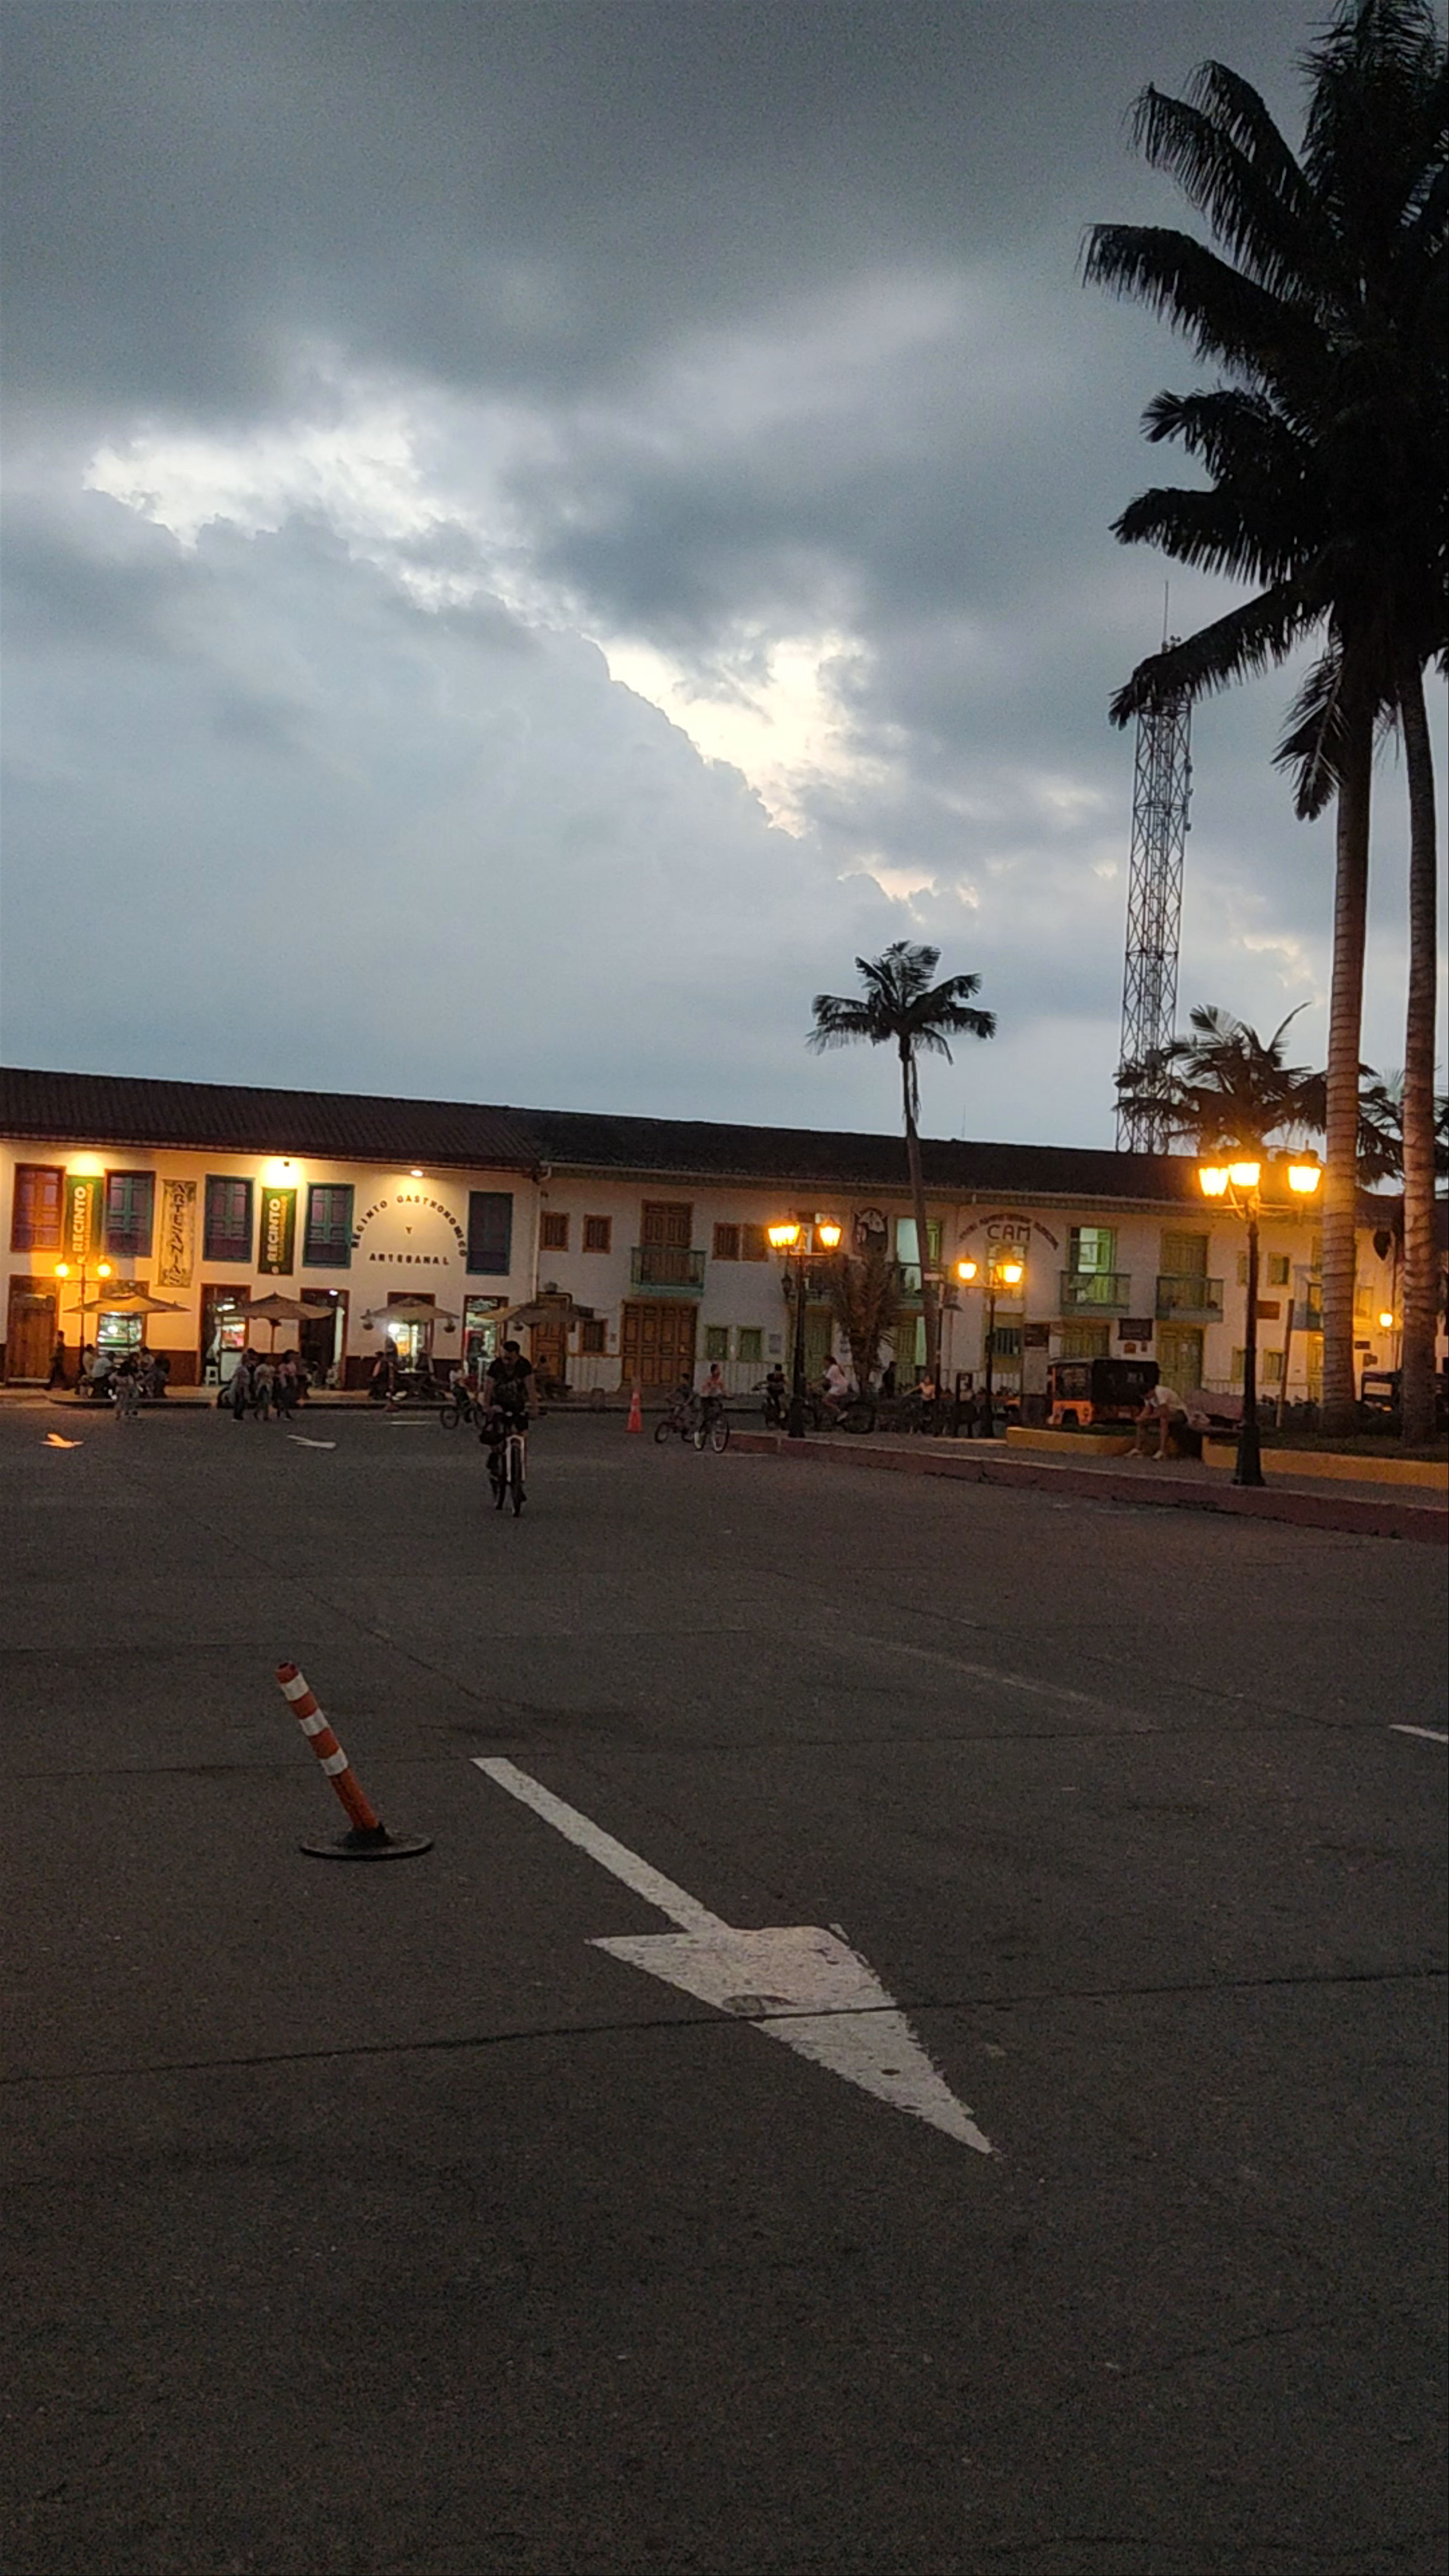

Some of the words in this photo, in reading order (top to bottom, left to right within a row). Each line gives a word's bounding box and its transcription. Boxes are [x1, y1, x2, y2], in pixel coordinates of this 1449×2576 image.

[72, 1186, 86, 1252] RECINTO
[267, 1198, 280, 1261] RECINTO
[351, 1200, 388, 1248] RECINTO
[987, 1224, 1031, 1241] CAM
[369, 1252, 449, 1265] ARTESANAL
